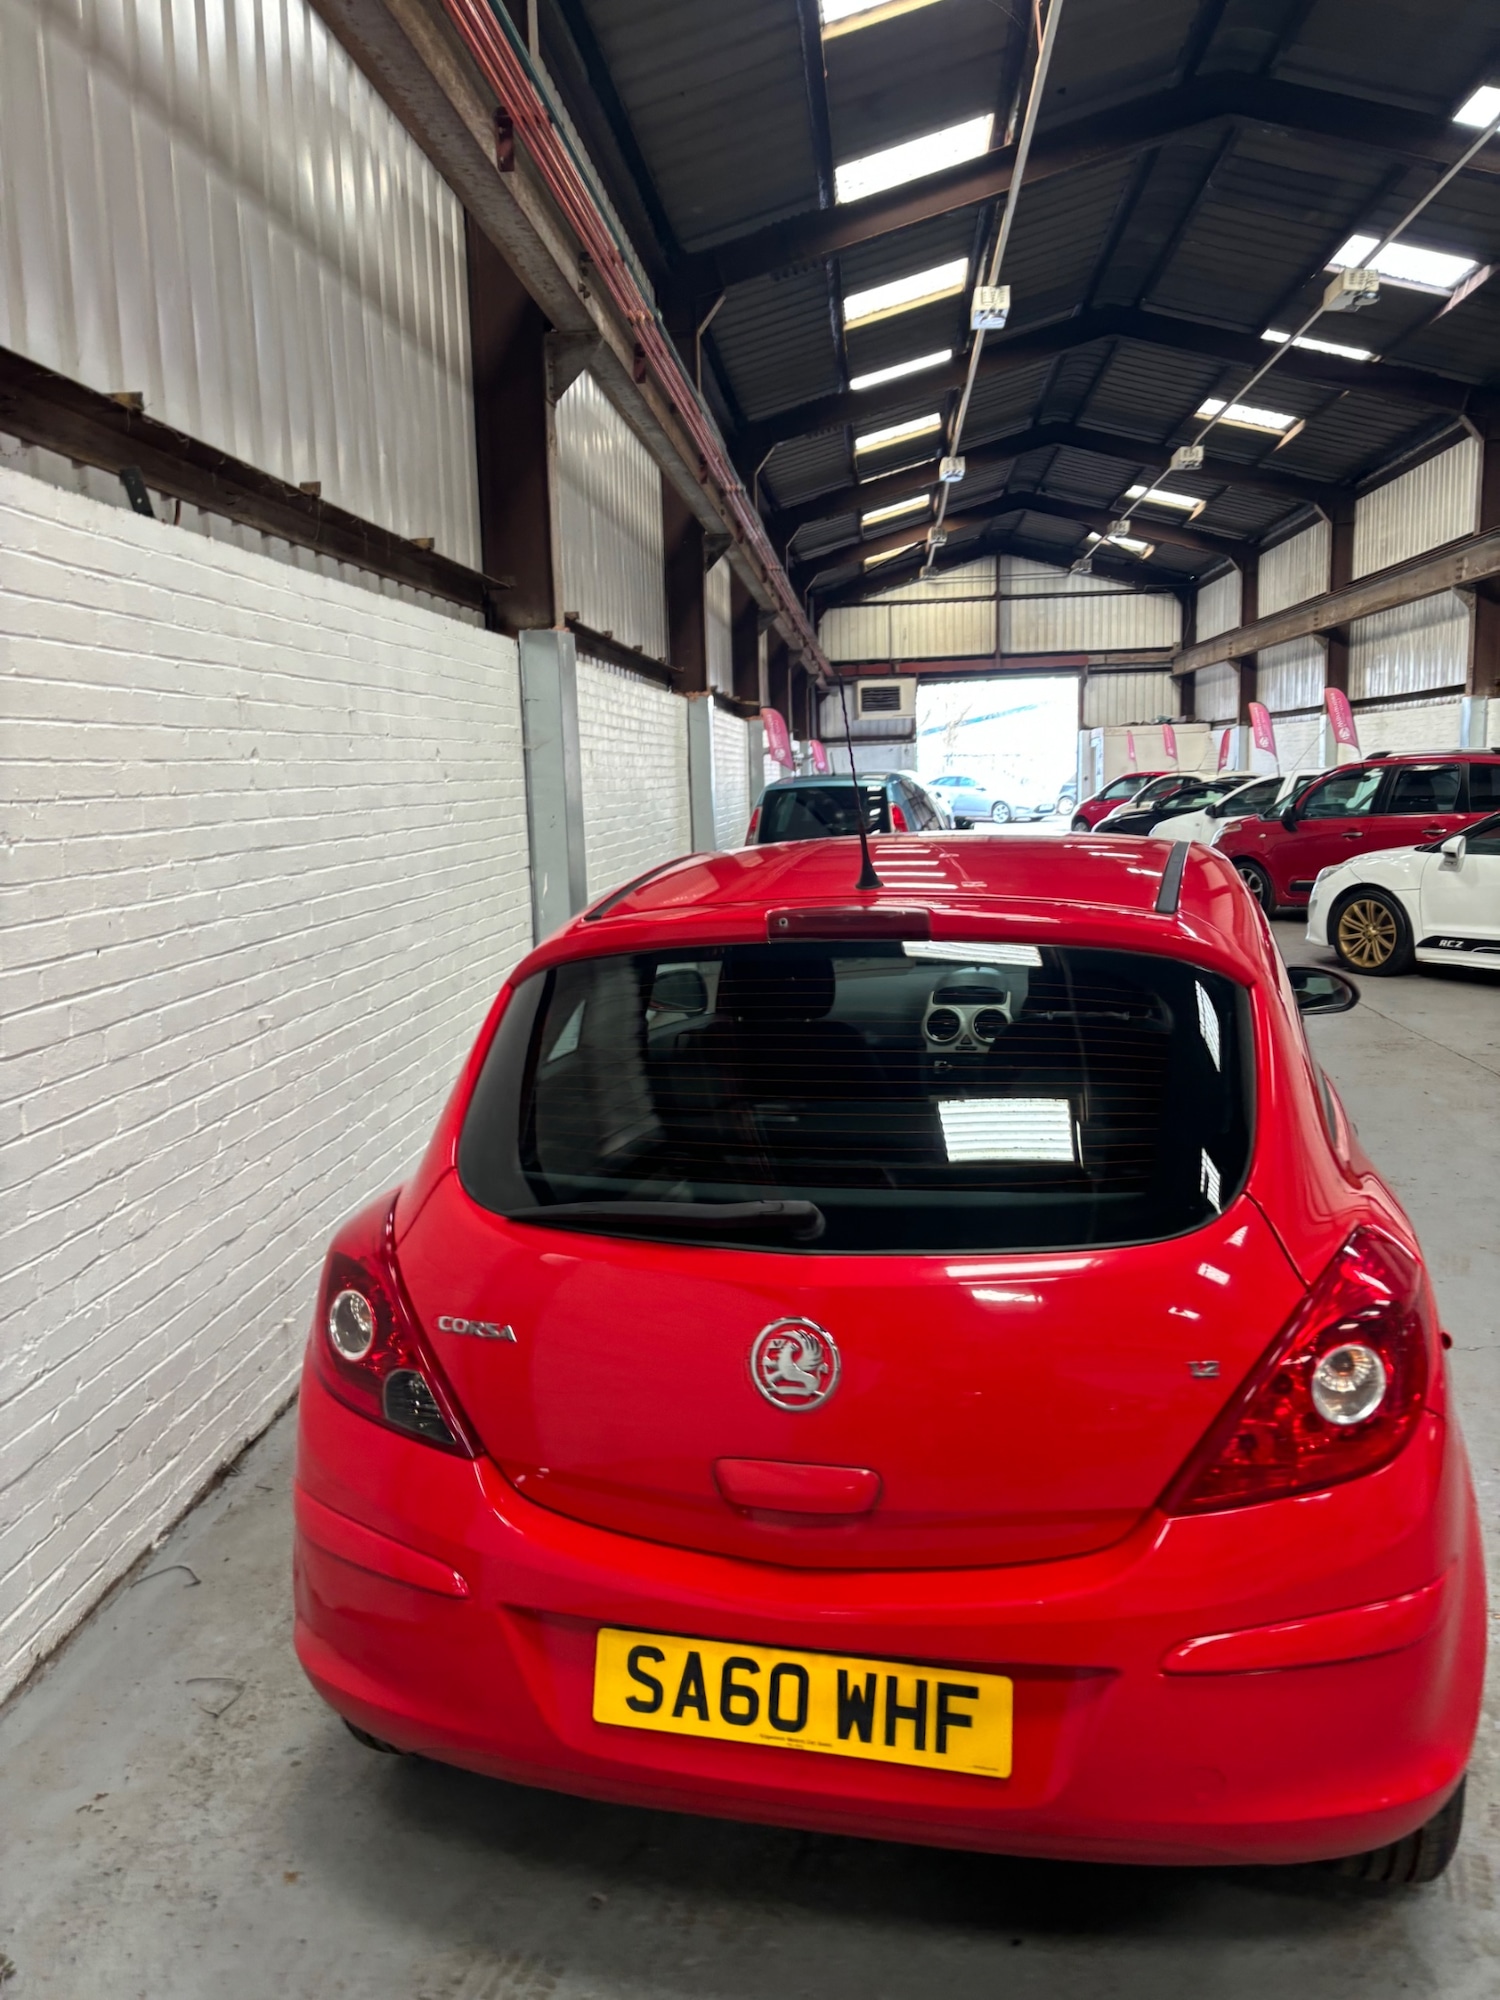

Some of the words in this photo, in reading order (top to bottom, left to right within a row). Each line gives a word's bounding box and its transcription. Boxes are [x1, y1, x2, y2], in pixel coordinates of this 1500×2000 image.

[1438, 939, 1464, 948] RCZ
[438, 1315, 517, 1343] CORSA
[625, 1645, 810, 1733] SA60
[836, 1668, 979, 1754] WHF
